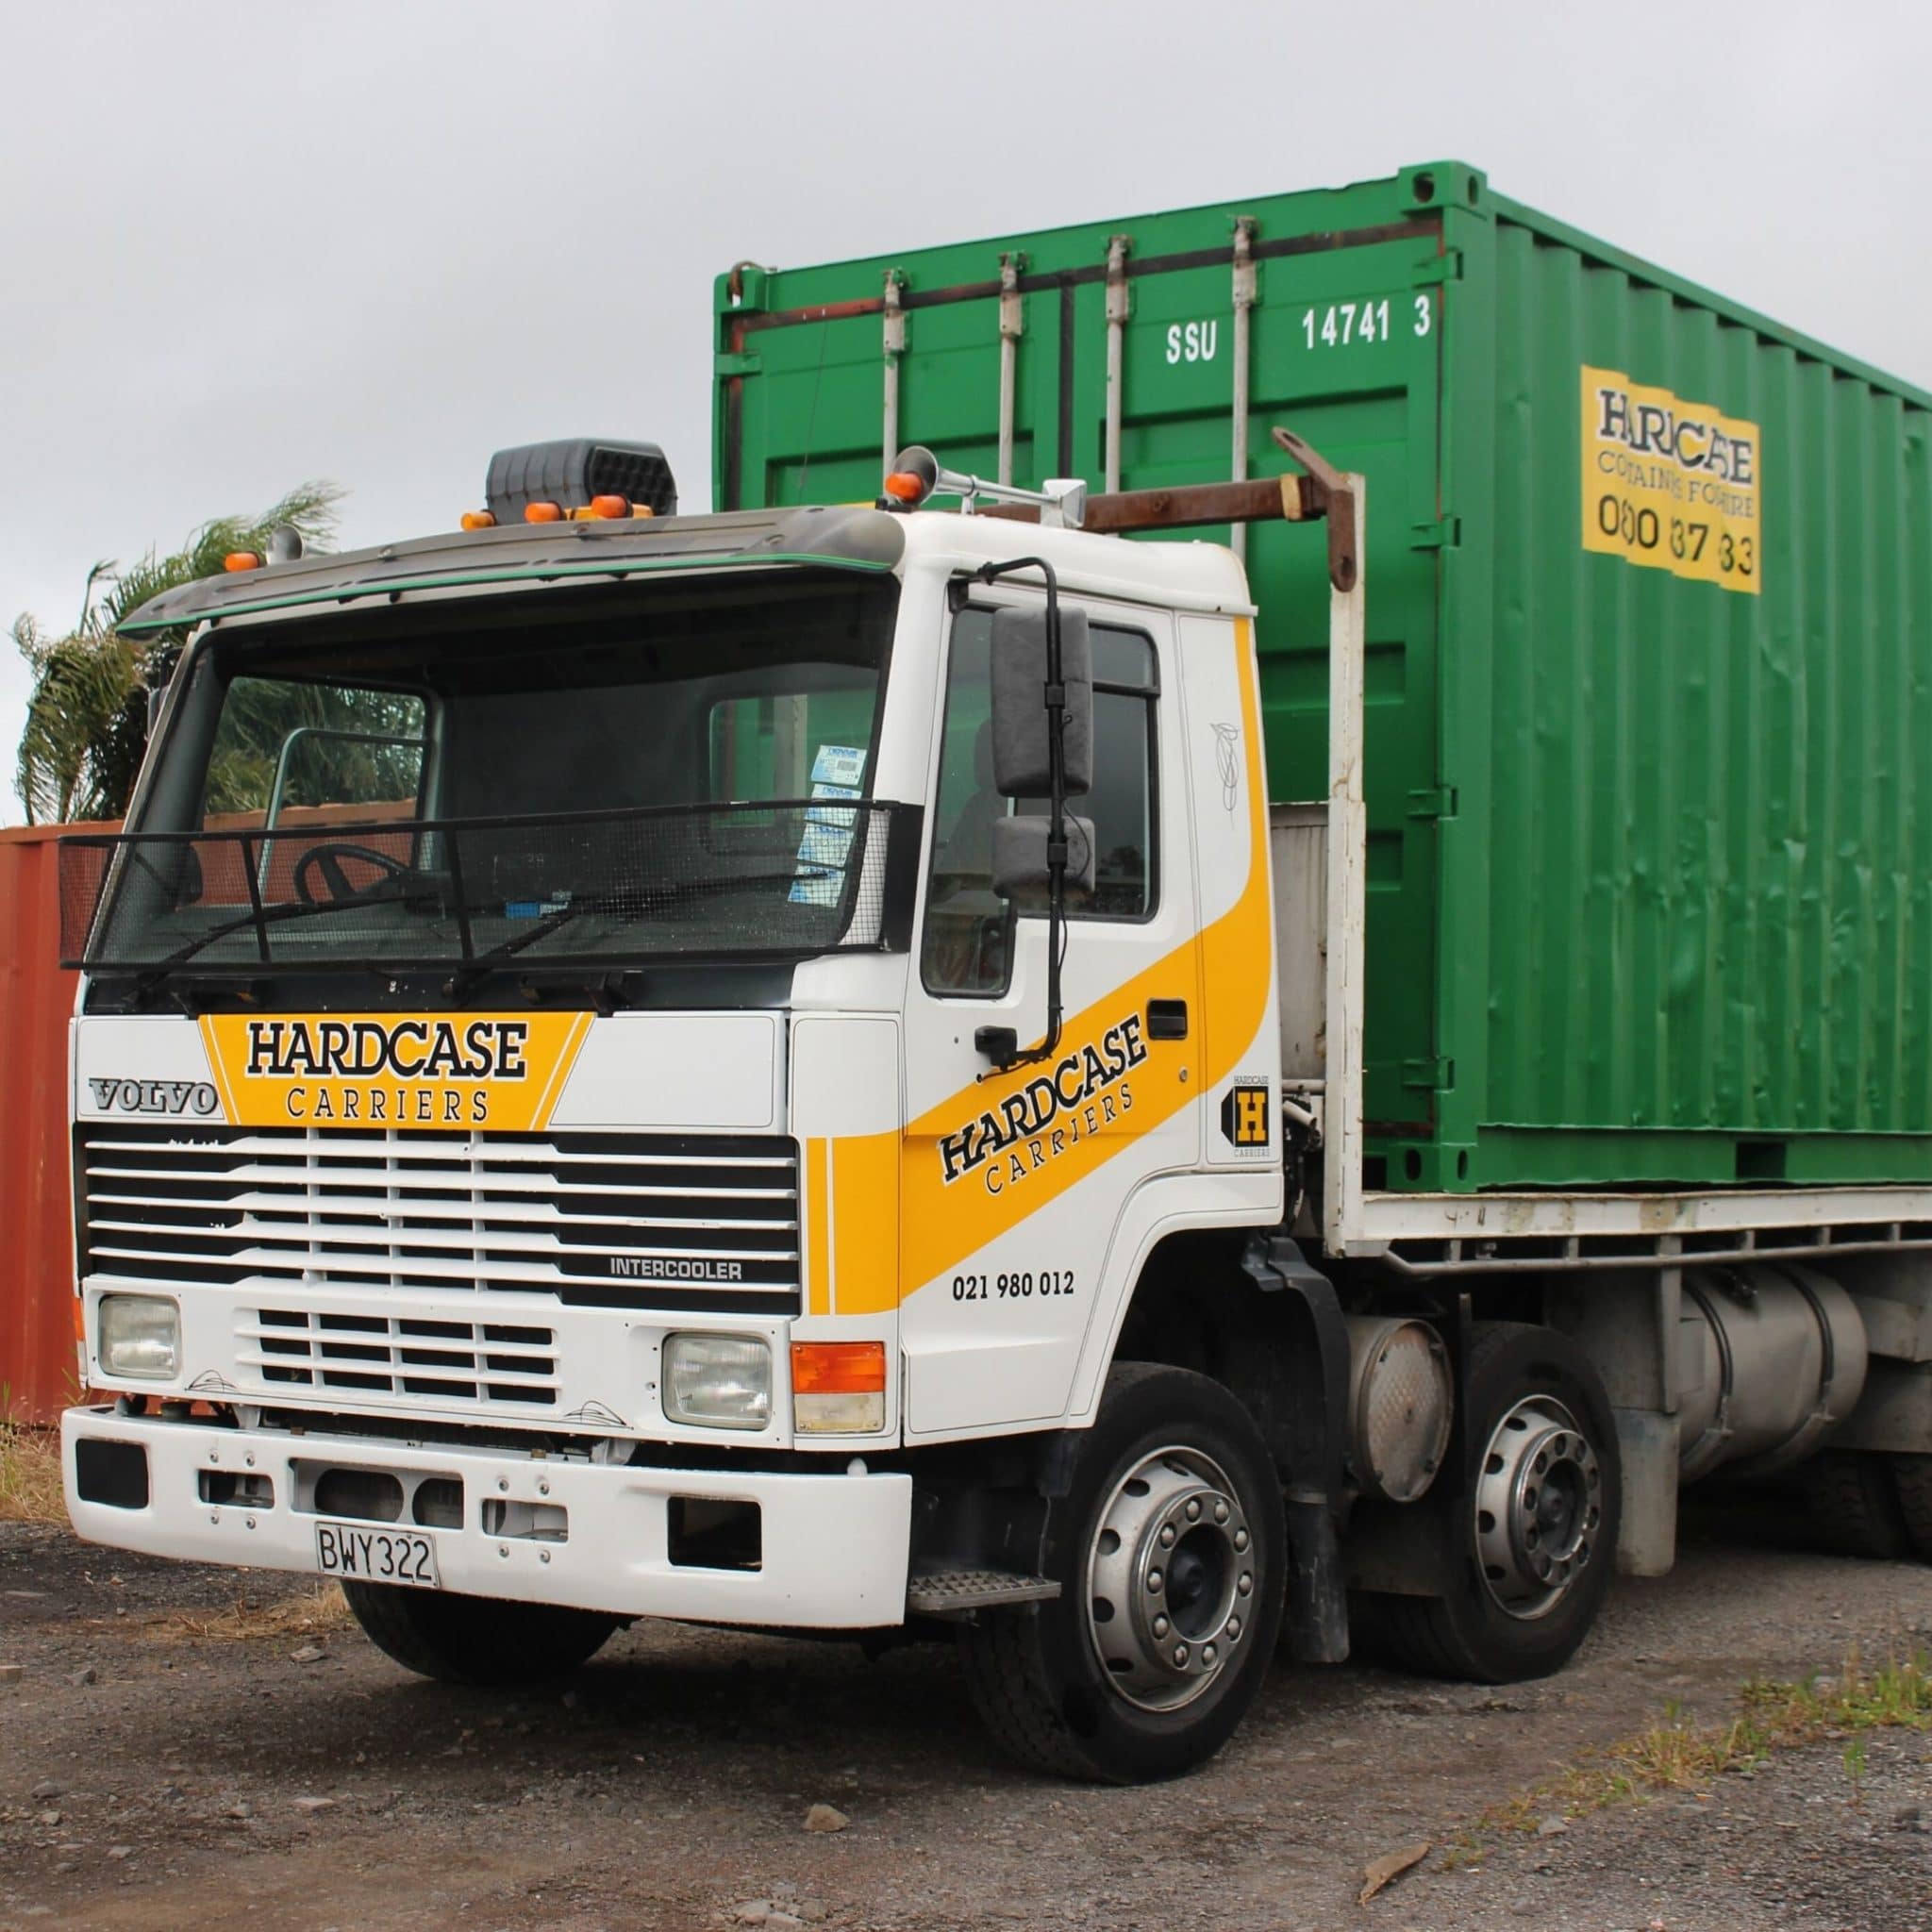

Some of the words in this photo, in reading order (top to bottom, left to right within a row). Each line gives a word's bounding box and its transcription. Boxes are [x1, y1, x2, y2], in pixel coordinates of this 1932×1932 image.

[1166, 321, 1216, 364] SSU
[1303, 299, 1389, 349] 14741
[1414, 294, 1430, 337] 3
[247, 1021, 528, 1078] HARDCASE
[90, 1078, 218, 1116] VOLVO
[286, 1087, 489, 1122] CARRIERS
[940, 1013, 1148, 1183] HARDCASE
[986, 1083, 1133, 1194] CARRIERS
[610, 1257, 742, 1280] INTERCOOLER
[953, 1275, 988, 1301] 021
[997, 1273, 1033, 1298] 980
[1040, 1271, 1074, 1295] 012
[318, 1527, 432, 1581] BWY322
